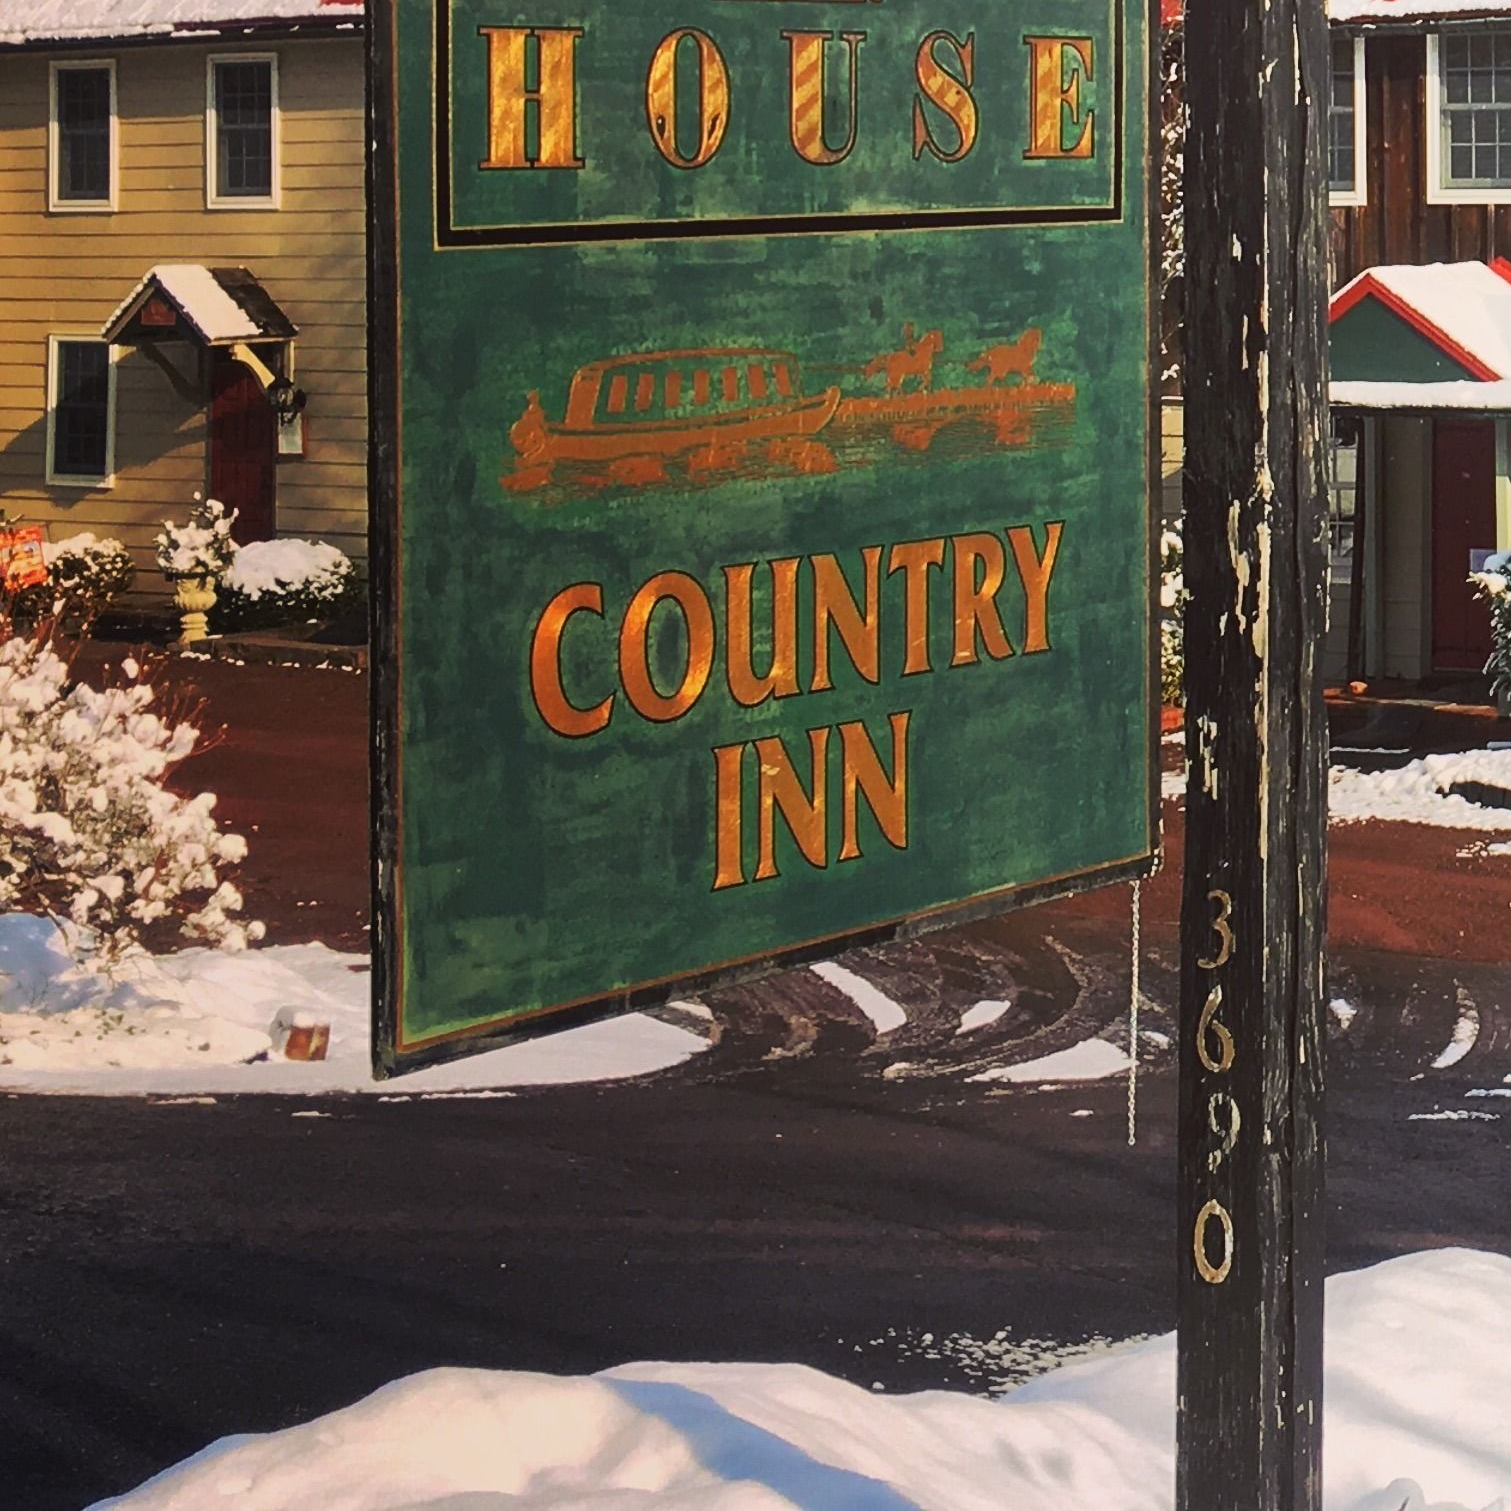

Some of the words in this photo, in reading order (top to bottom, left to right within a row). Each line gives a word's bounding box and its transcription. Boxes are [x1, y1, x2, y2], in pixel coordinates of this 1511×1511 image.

[478, 26, 1094, 170] HOUSE
[529, 520, 1065, 739] COUNTRY
[712, 710, 911, 891] INN
[1194, 889, 1241, 1283] 3690
